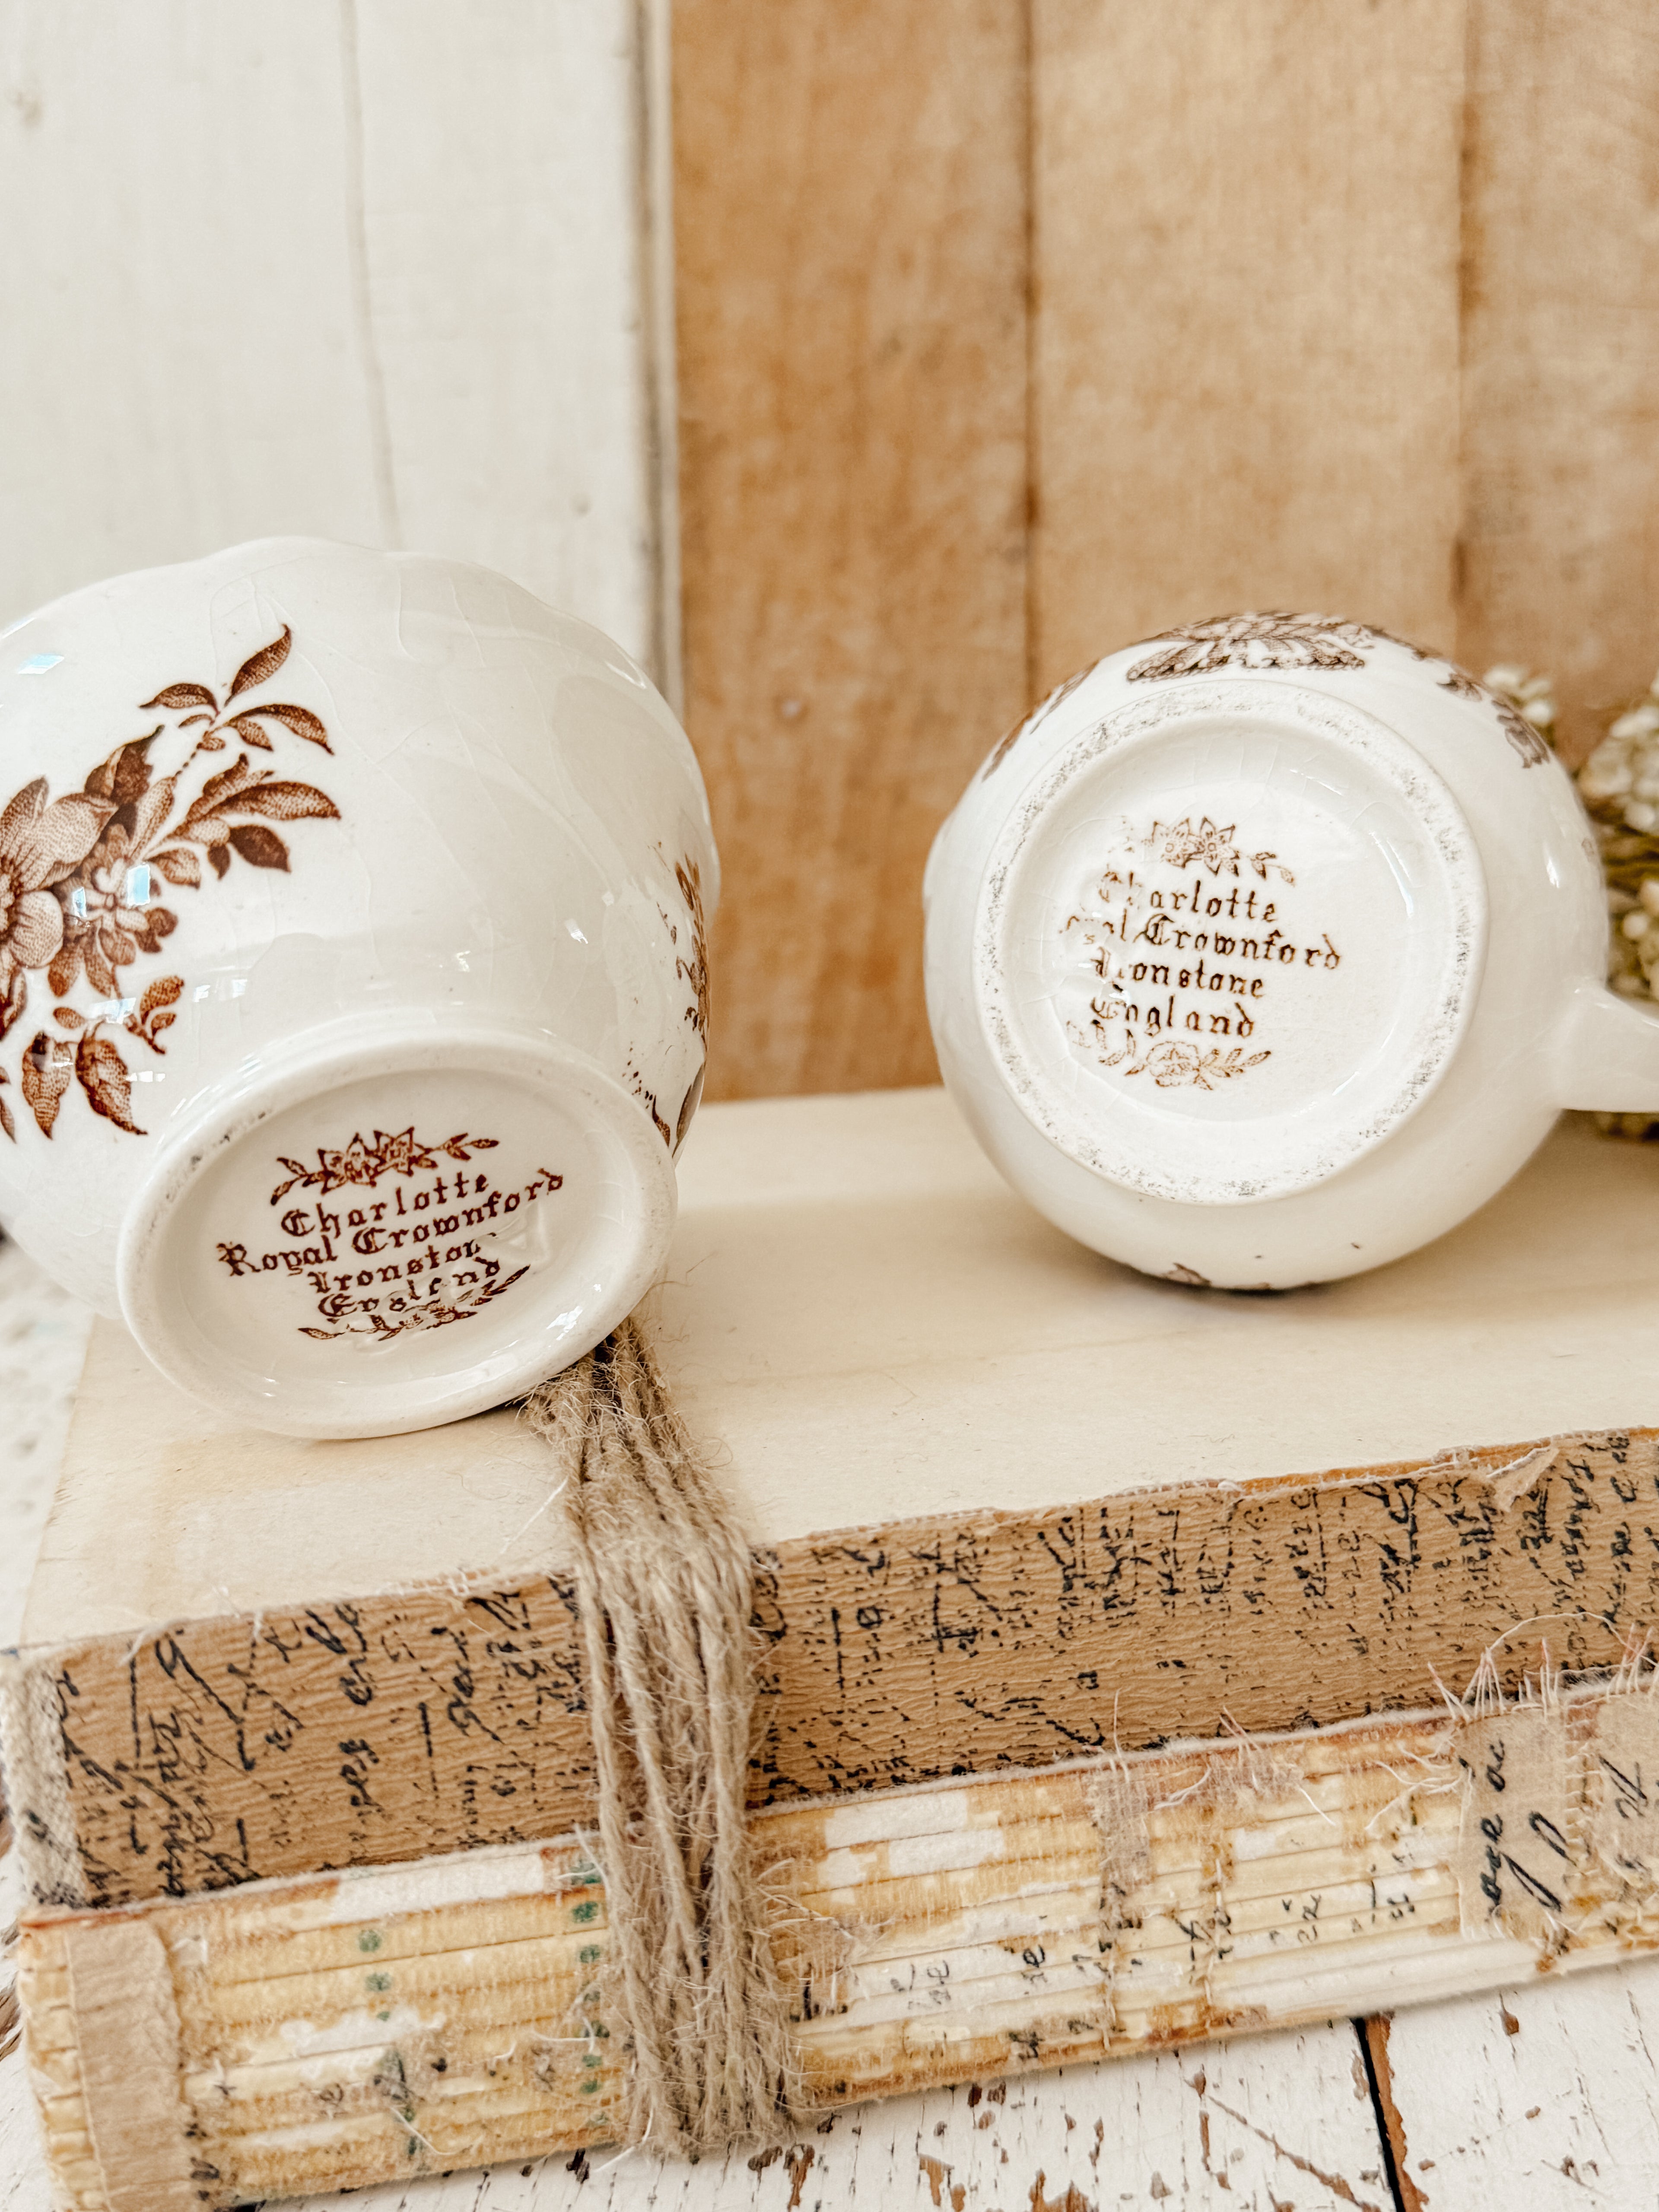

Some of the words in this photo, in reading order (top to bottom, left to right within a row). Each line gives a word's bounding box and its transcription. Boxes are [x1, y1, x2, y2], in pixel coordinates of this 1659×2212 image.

[1133, 912, 1341, 970] Crownford
[216, 1234, 338, 1277] Royal
[351, 1168, 563, 1255] Crownford
[280, 1171, 489, 1239] Charlotte
[307, 1232, 498, 1294] Ironston
